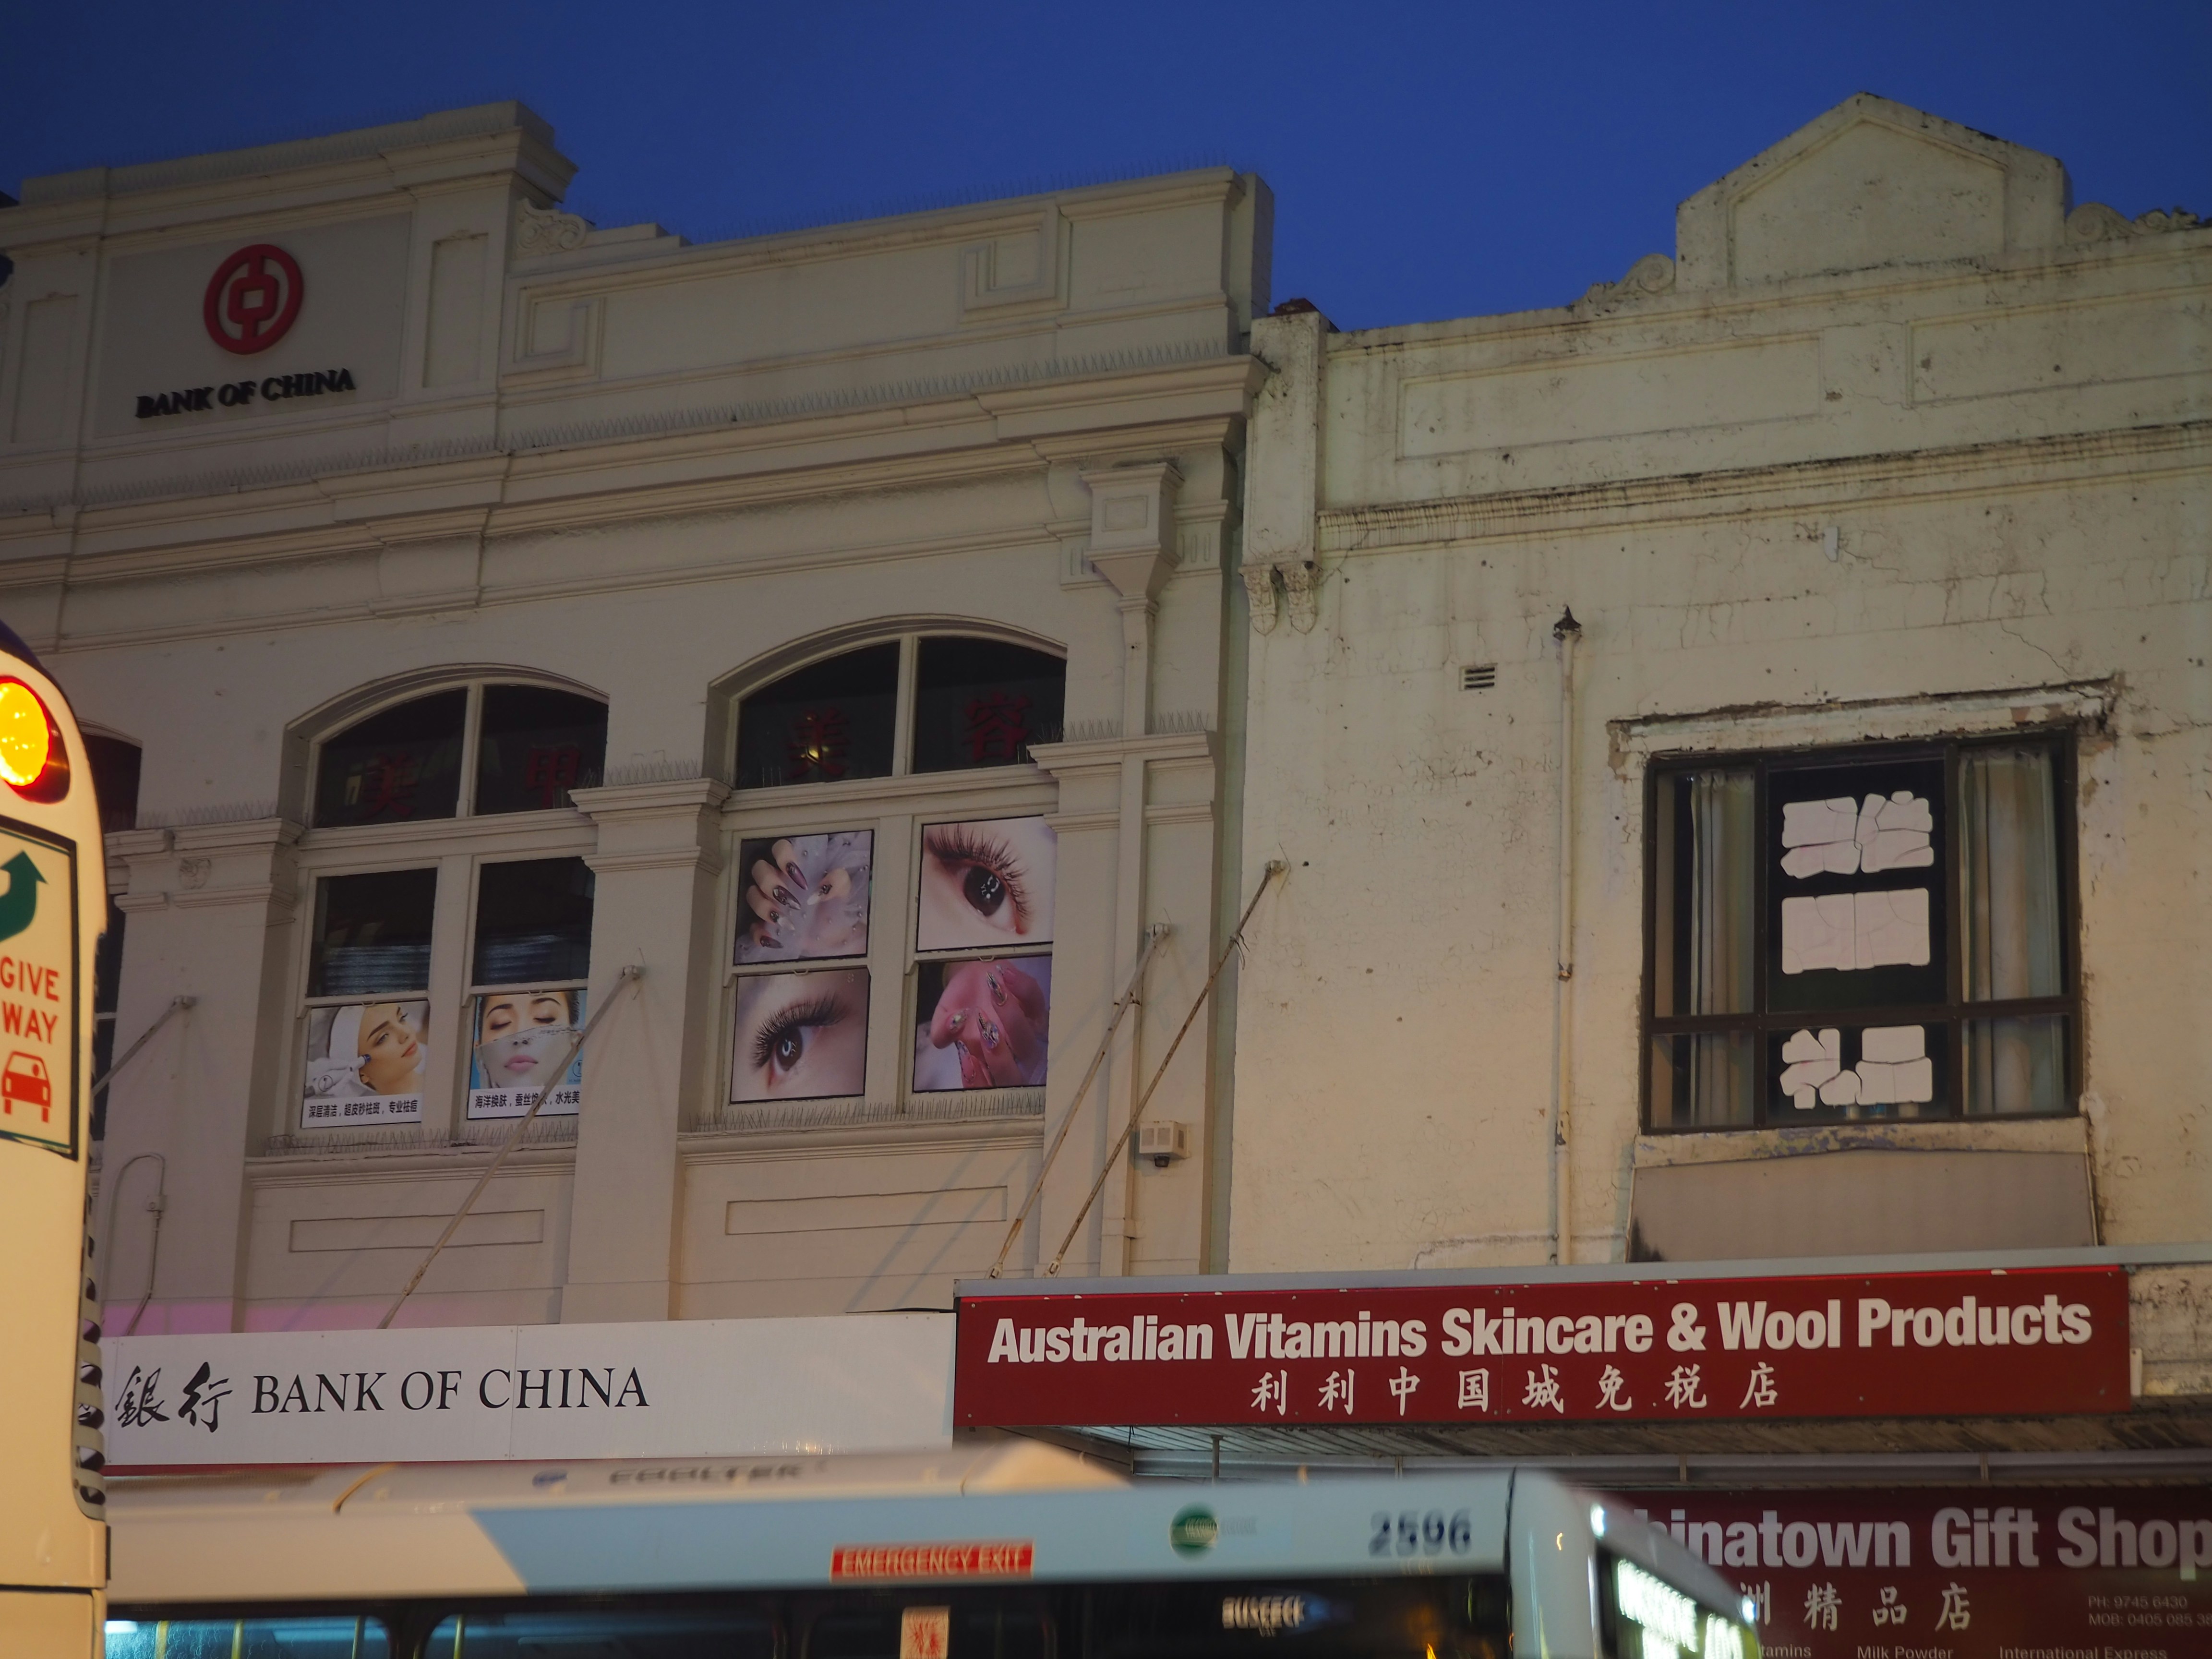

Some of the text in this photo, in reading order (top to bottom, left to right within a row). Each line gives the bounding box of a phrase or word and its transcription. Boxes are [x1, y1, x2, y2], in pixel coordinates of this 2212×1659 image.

[135, 368, 356, 419] BANK OF CHINA
[0, 957, 60, 1003] GIVE
[2, 1000, 58, 1044] WAY
[987, 1294, 2092, 1363] Australian Vitamins Skincare & Wool Products
[251, 1367, 650, 1413] BANK OF CHINA
[1251, 1361, 1778, 1416] 利利中国城免税店
[1368, 1508, 1472, 1557] 2596
[1931, 1506, 2040, 1569] Gift
[2057, 1506, 2212, 1581] Shop
[842, 1542, 1026, 1578] EMERGENCY EXIT
[2088, 1596, 2110, 1608] PH:
[2114, 1596, 2148, 1609] 9745
[2088, 1613, 2124, 1626] MOB:
[1857, 1645, 1954, 1659] Milk Powder
[1999, 1646, 2168, 1659] International Express
